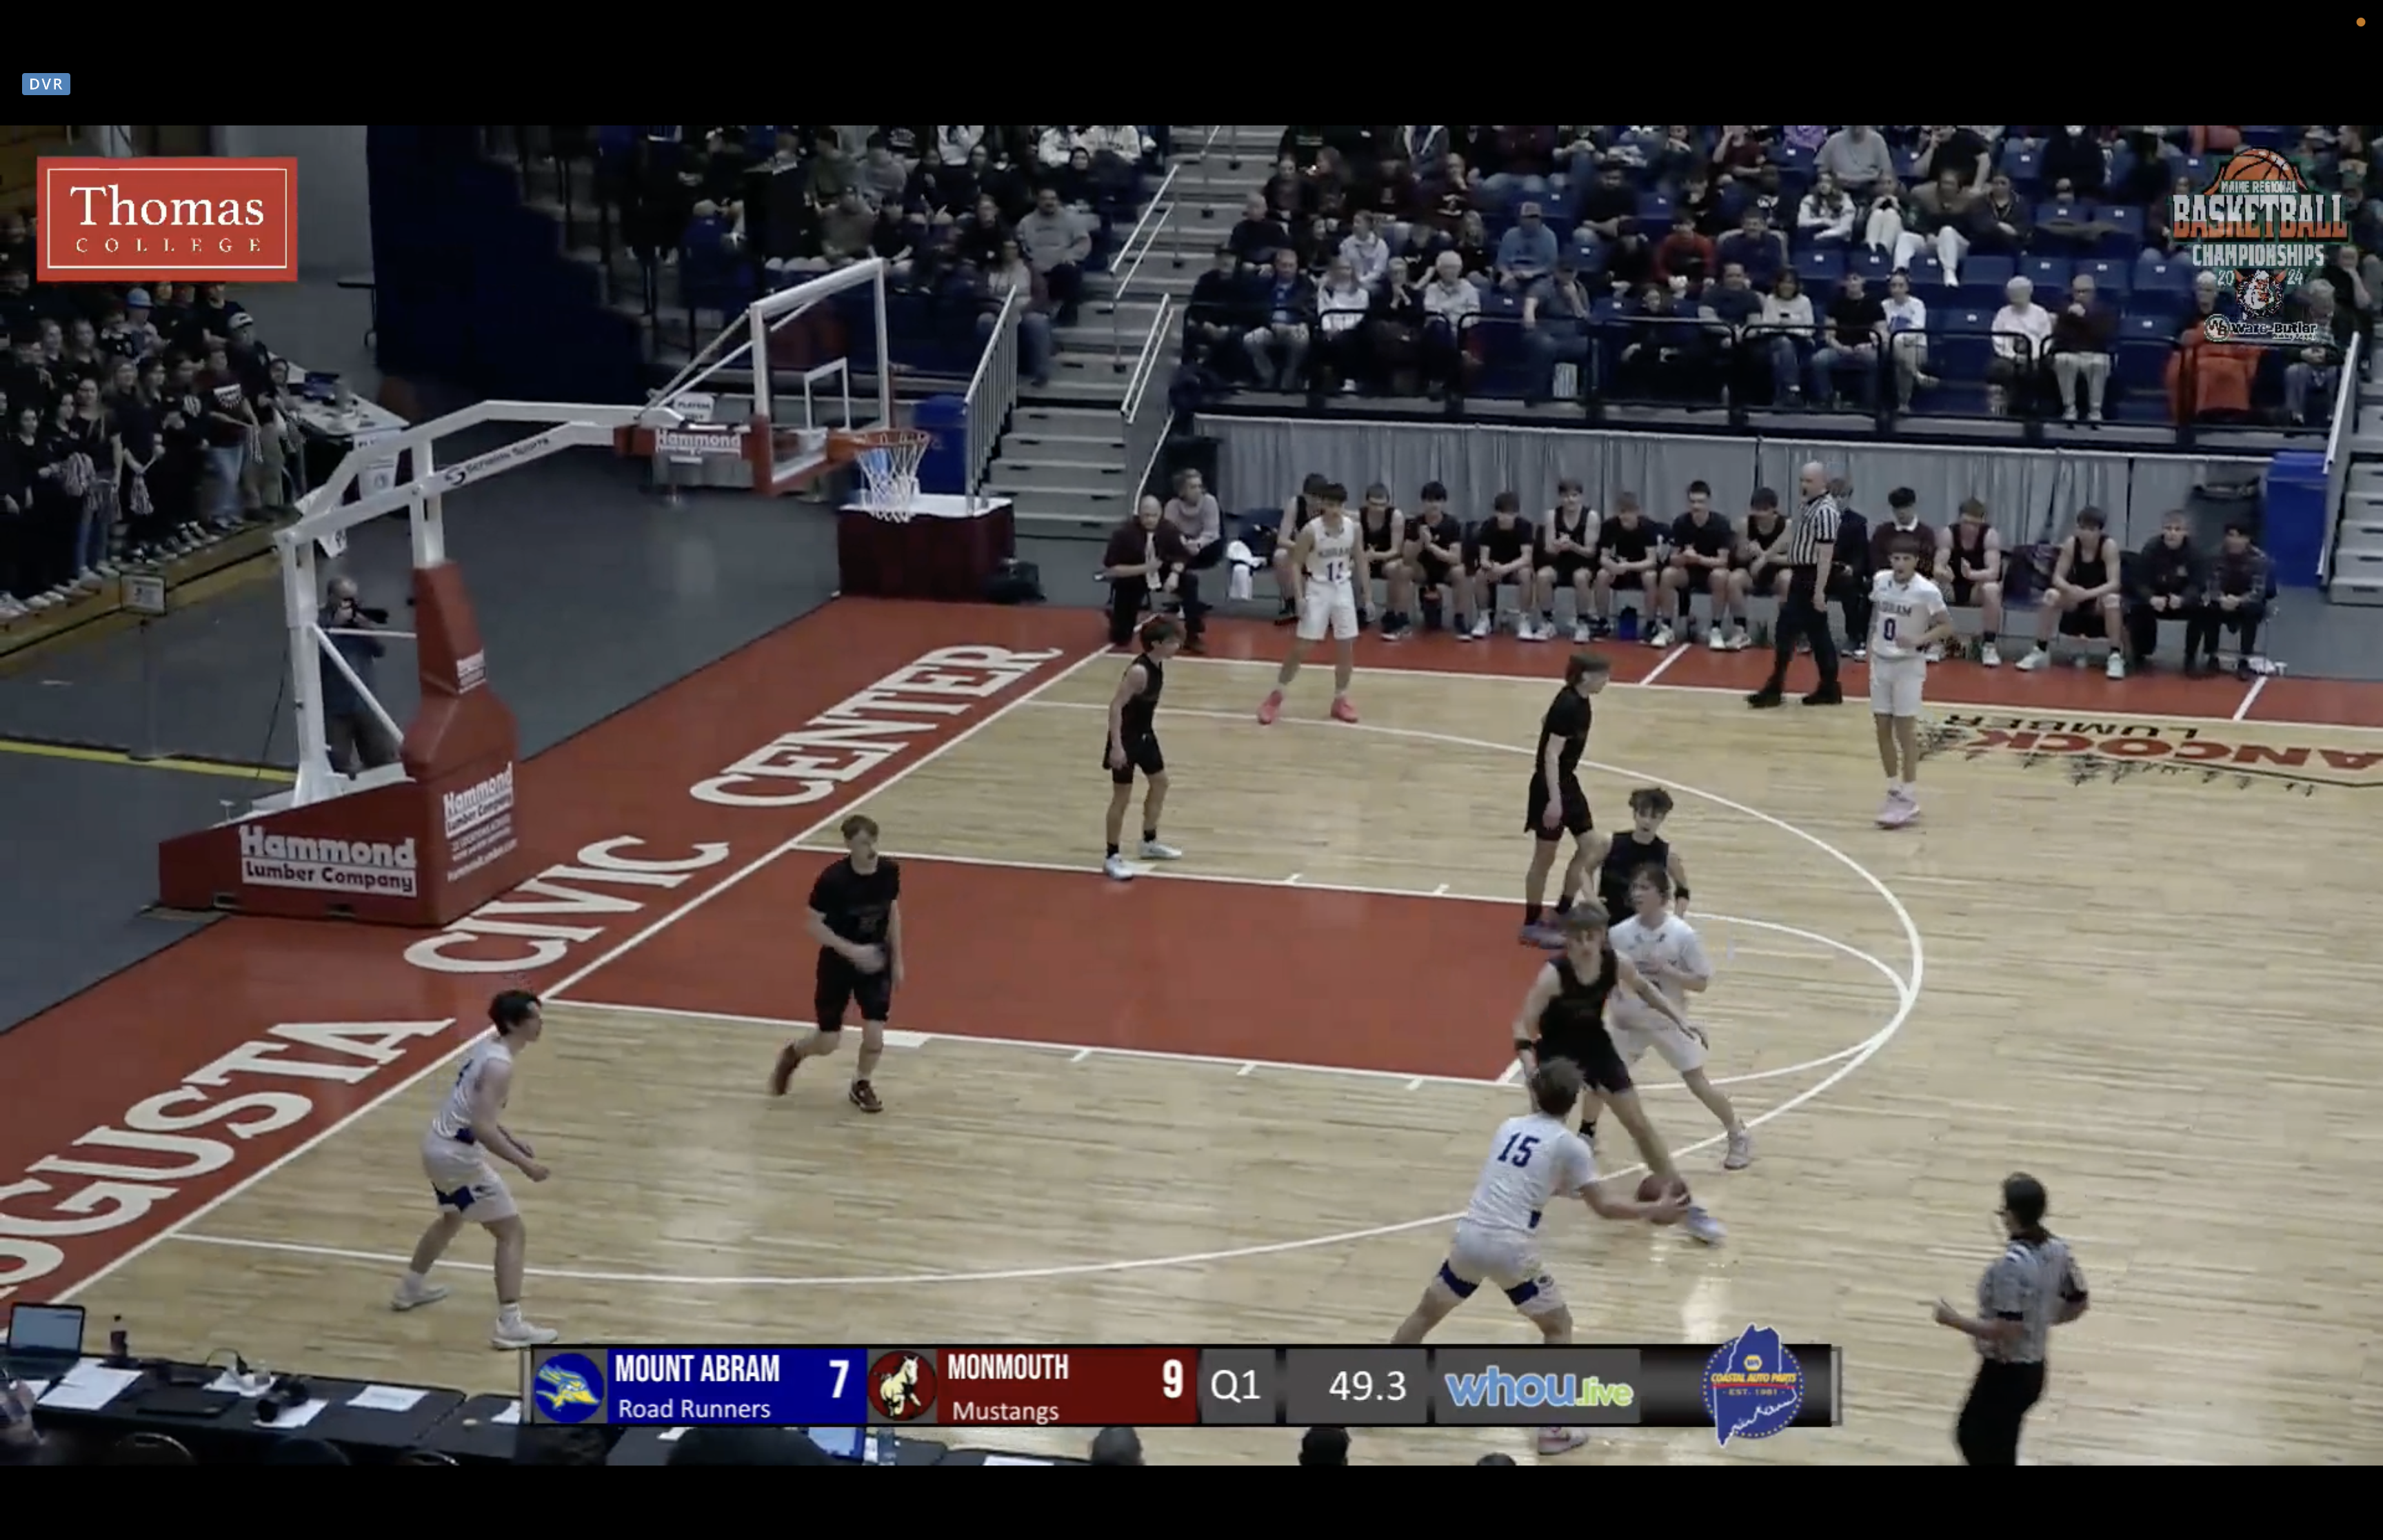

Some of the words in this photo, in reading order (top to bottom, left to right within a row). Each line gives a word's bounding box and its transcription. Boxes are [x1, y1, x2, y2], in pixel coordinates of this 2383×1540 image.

[655, 428, 741, 448] Hammond
[1884, 618, 1896, 641] 0
[690, 645, 1063, 807] CENTER
[443, 761, 512, 818] Hammond
[239, 825, 416, 869] Hammond
[246, 861, 314, 882] Lumber
[321, 867, 413, 892] Company
[403, 835, 730, 973] CIVIC
[0, 1017, 456, 1299] GUSTA
[1497, 1132, 1540, 1168] 15
